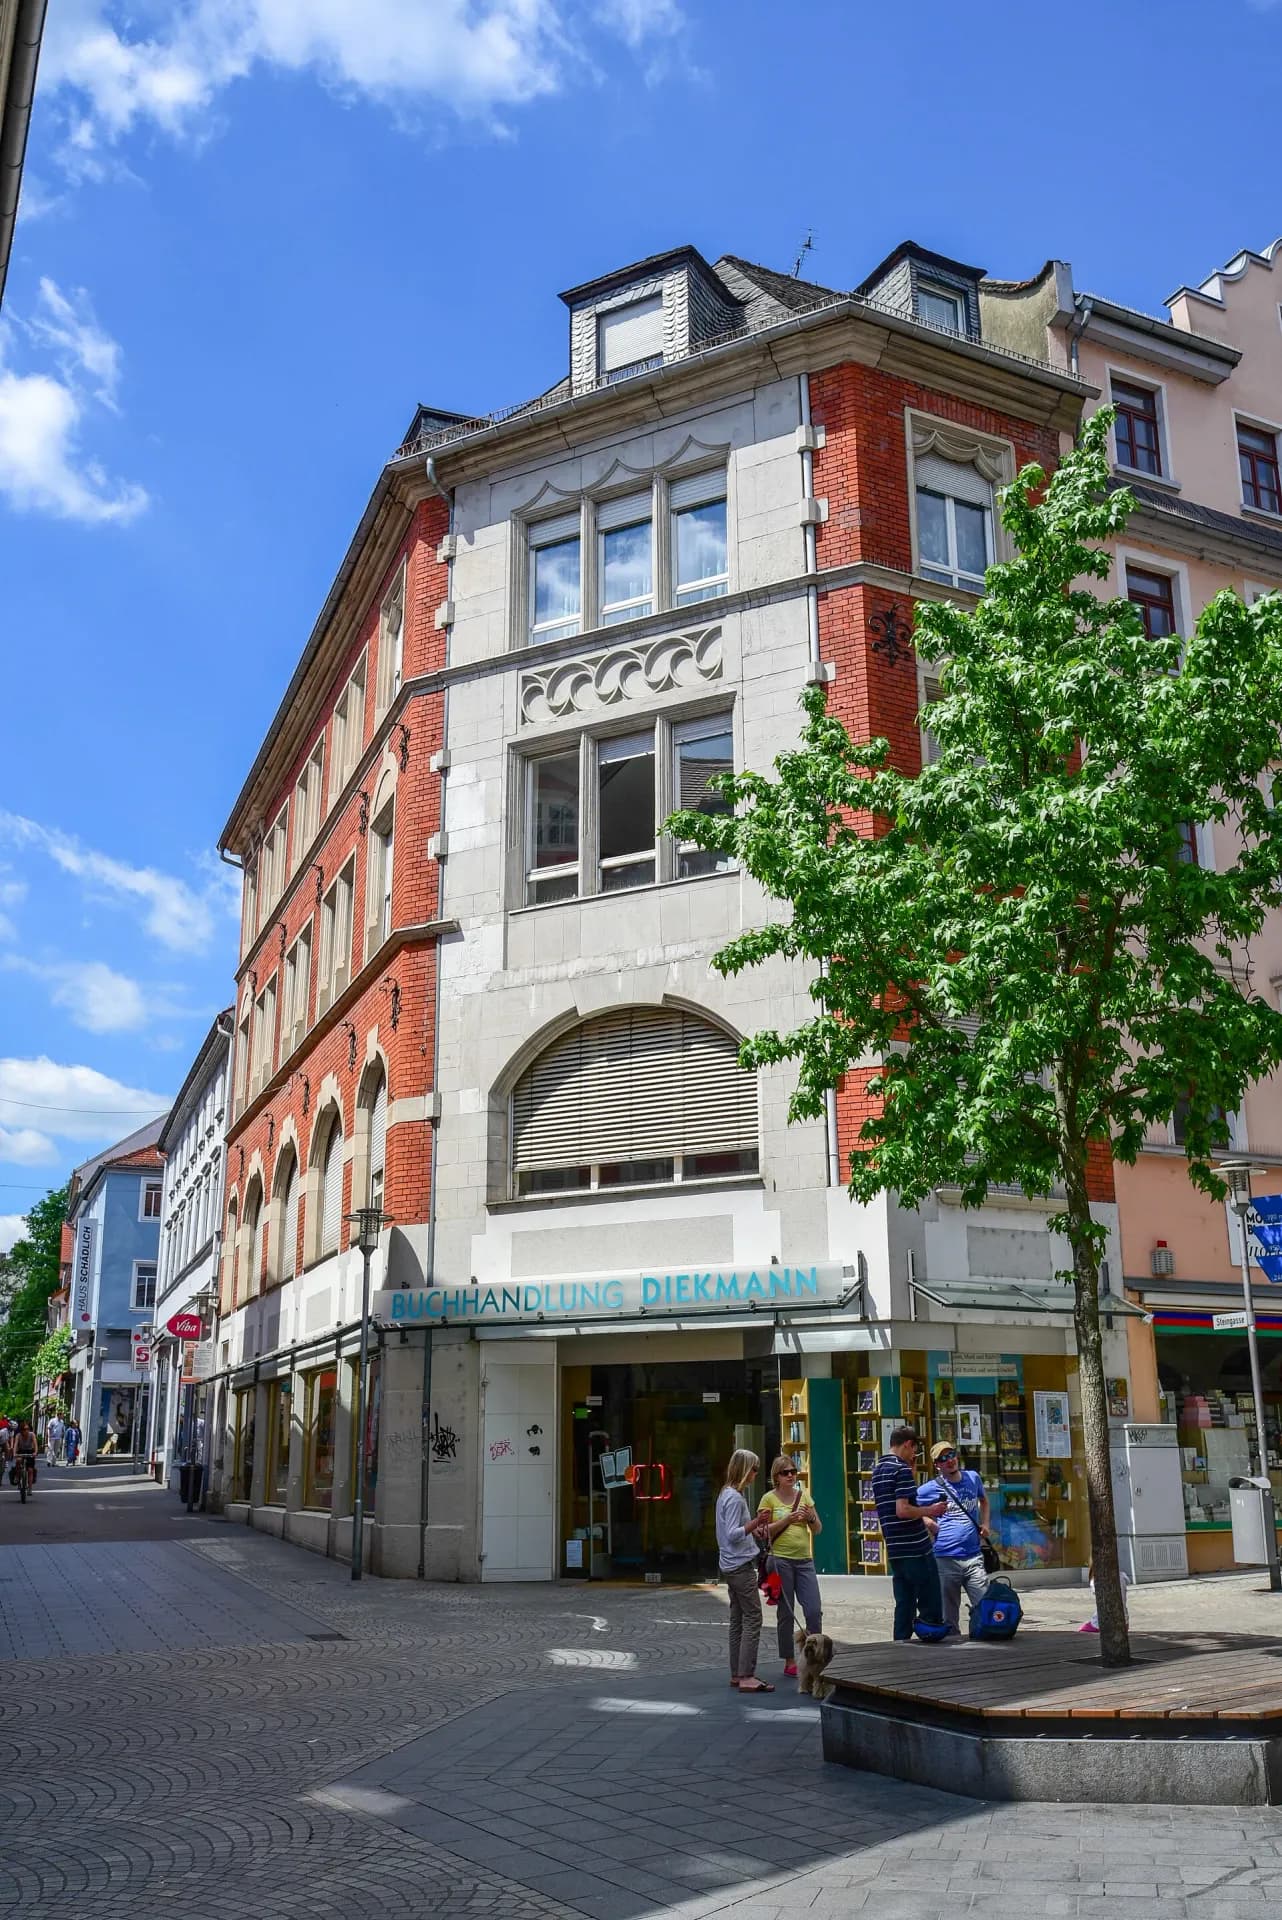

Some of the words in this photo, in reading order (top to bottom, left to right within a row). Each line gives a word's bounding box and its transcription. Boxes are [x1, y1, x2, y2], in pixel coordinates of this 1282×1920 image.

[80, 1226, 91, 1283] SCHÄDLICH
[79, 1285, 88, 1311] HAUS
[391, 1280, 624, 1319] BUCHHANDLUNG
[642, 1267, 817, 1305] DIEKMANN
[176, 1319, 197, 1332] Viba
[1216, 1317, 1245, 1328] Steingasse
